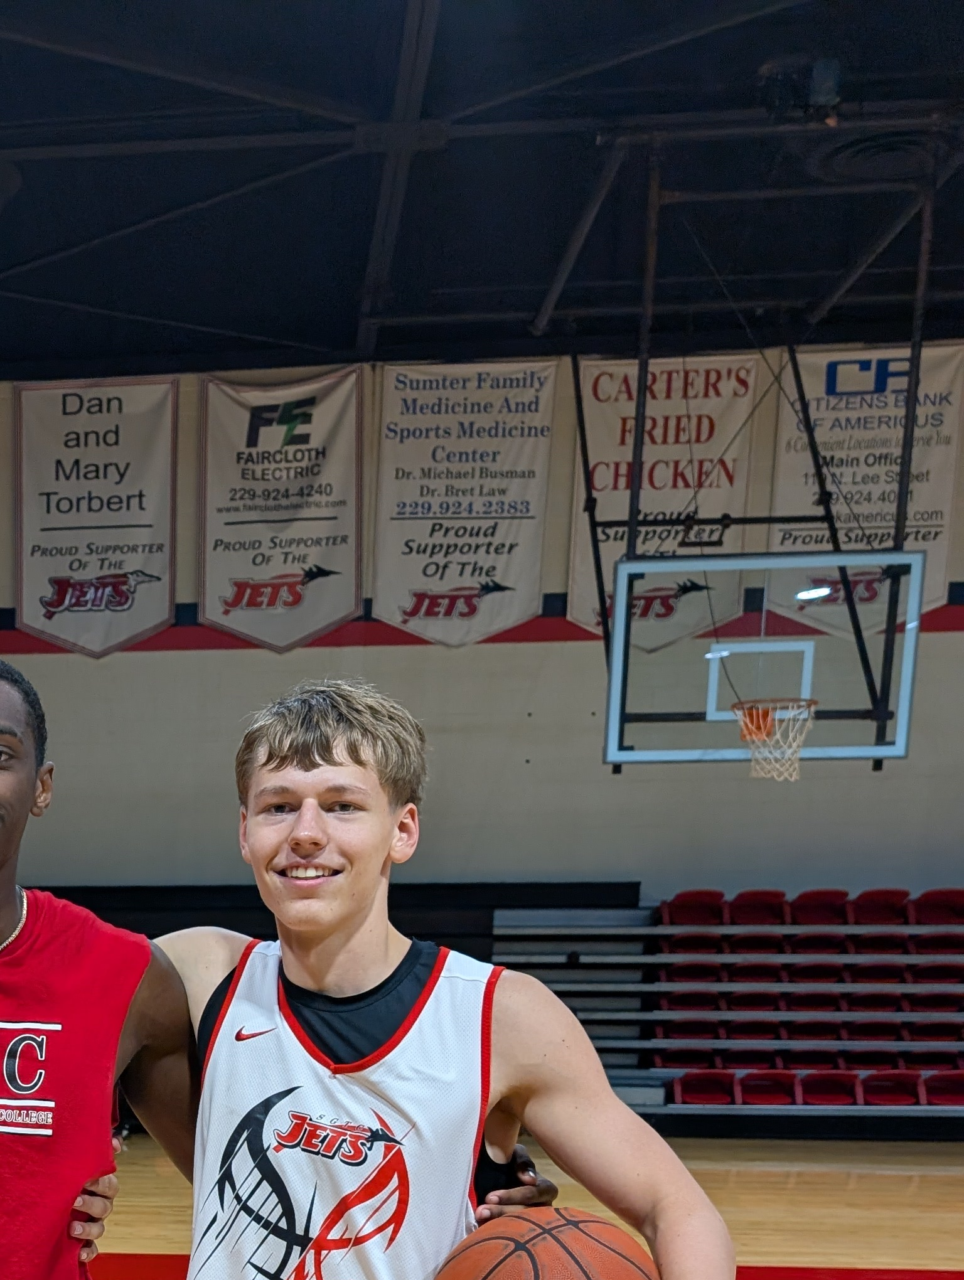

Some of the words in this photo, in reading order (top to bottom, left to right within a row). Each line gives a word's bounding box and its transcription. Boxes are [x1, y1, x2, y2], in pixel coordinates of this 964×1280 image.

[394, 372, 471, 391] Sumter
[476, 371, 548, 393] Family
[591, 366, 751, 403] CARTER'S
[61, 393, 124, 416] Dan
[400, 397, 495, 416] Medicine
[498, 395, 540, 414] And
[63, 424, 119, 449] and
[385, 421, 452, 443] Sports
[456, 420, 551, 439] Medicine
[618, 413, 716, 447] FRIED
[236, 446, 327, 466] FAIRCLOTH
[431, 444, 501, 464] Center
[864, 451, 904, 467] Offic
[54, 458, 131, 486] Mary
[241, 463, 322, 482] ELECTRIC
[394, 467, 416, 480] Dr.
[419, 466, 475, 480] Michael
[478, 466, 537, 480] Busman
[851, 469, 881, 485] Lee
[229, 483, 333, 502] 229-924-4240
[419, 484, 441, 498] Dr.
[444, 484, 475, 498] Bret
[478, 484, 508, 497] Law
[38, 489, 147, 515] Torbert
[396, 500, 532, 516] 229.924.2383
[428, 521, 499, 538] Proud
[30, 544, 79, 558] PROUD
[84, 542, 165, 557] SUPPORTER
[212, 538, 263, 552] PROUD
[268, 534, 350, 551] SUPPORTER
[401, 538, 519, 558] Supporter
[69, 558, 91, 572] OF
[96, 557, 126, 571] THE
[251, 552, 274, 567] OF
[281, 551, 311, 565] THE
[422, 561, 453, 581] Of
[456, 561, 497, 578] The
[39, 575, 135, 612] JETS
[218, 578, 306, 611] JETS
[398, 589, 482, 620] JETS
[273, 1110, 370, 1167] JETS
